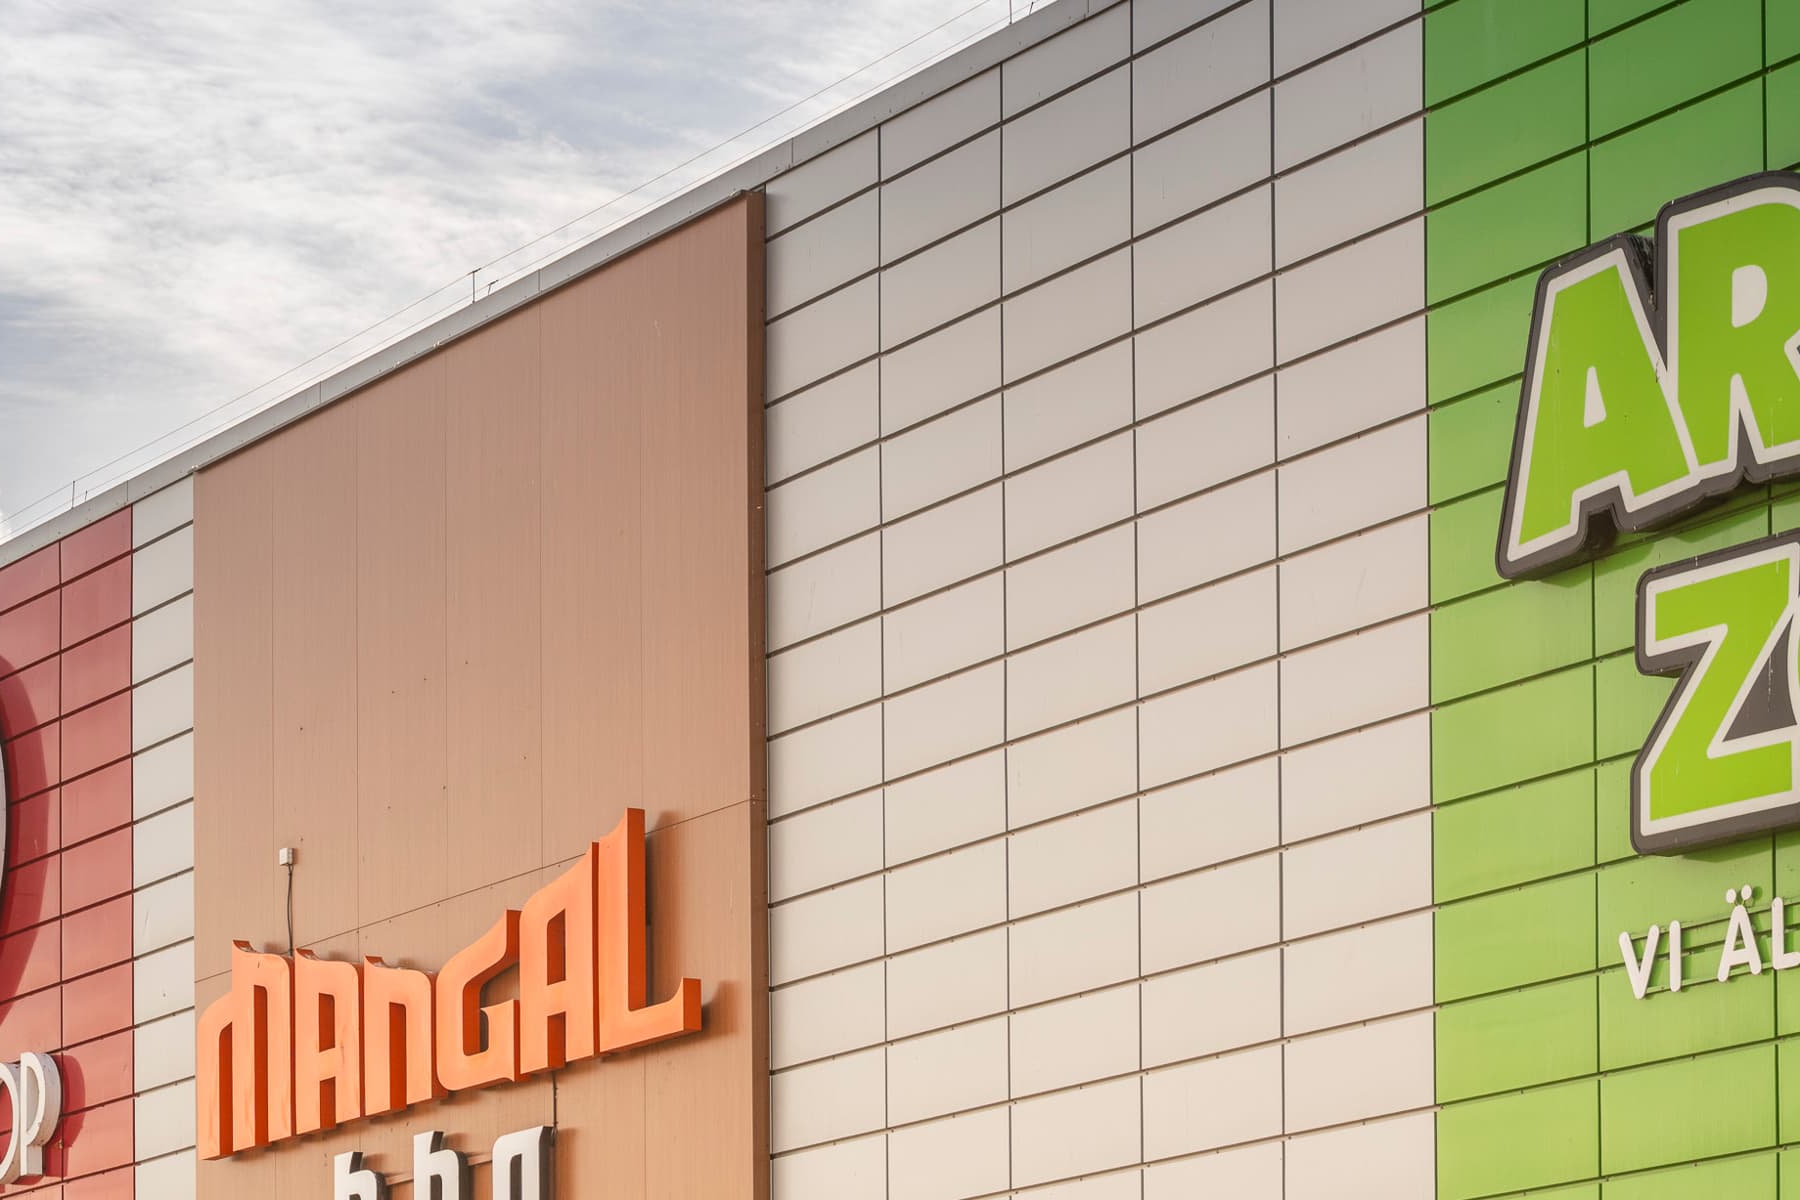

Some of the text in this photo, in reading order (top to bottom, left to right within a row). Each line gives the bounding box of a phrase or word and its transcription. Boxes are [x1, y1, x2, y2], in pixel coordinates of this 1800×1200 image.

[1630, 530, 1800, 856] Z
[198, 808, 701, 1160] MANGAL
[1618, 920, 1682, 1000] VI
